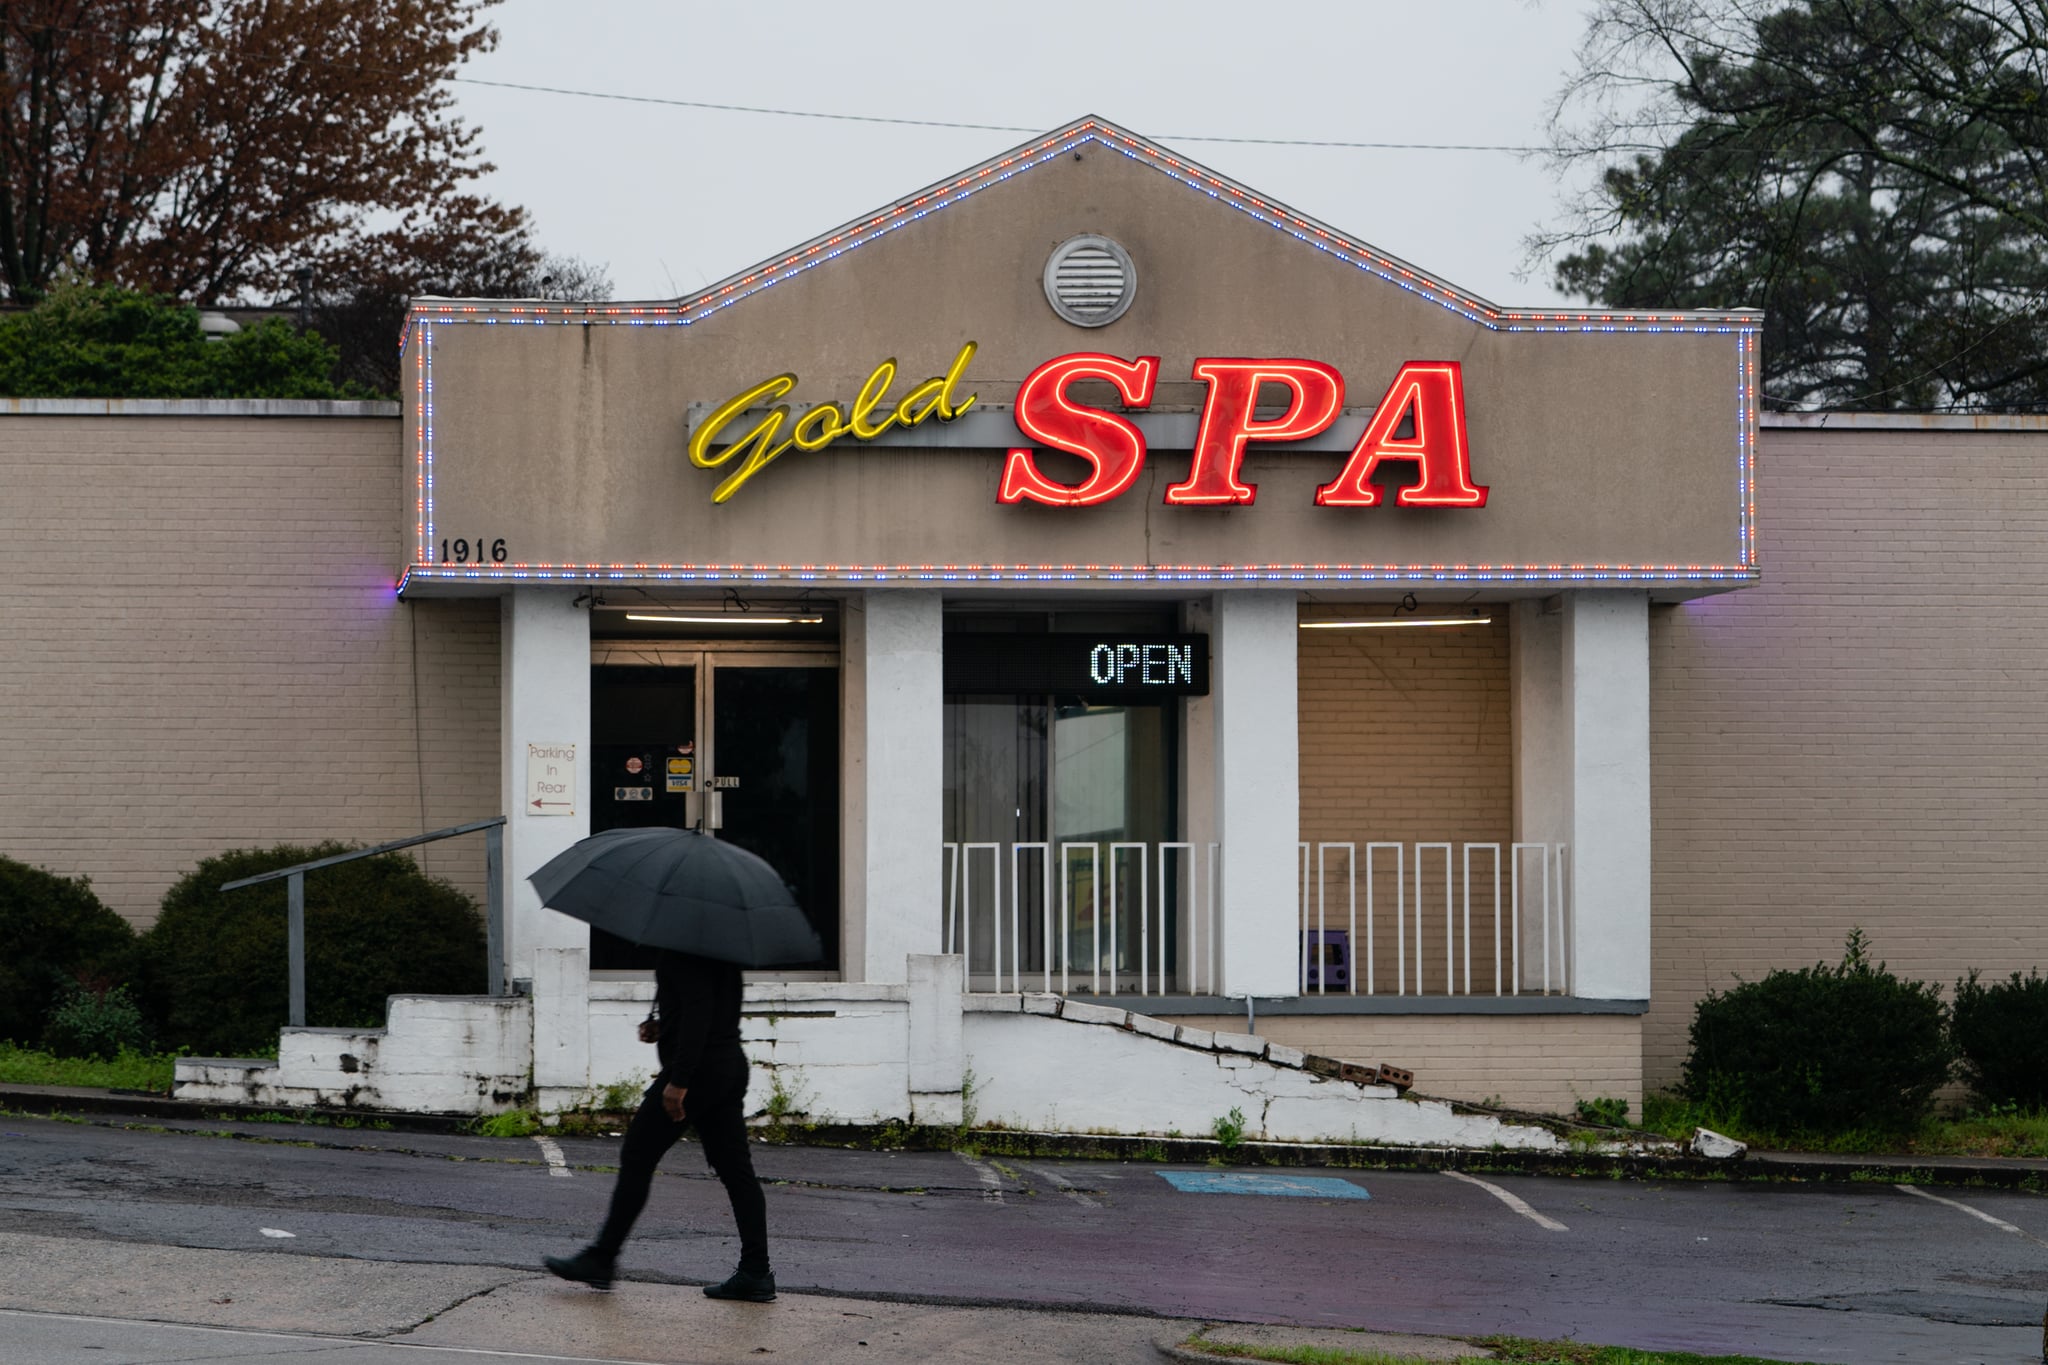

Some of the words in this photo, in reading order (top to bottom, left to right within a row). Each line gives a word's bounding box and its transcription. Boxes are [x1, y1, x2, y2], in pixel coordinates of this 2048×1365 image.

[687, 340, 979, 504] Gold
[996, 352, 1489, 508] SPA
[442, 538, 507, 562] 1916
[1090, 644, 1191, 684] OPEN
[530, 746, 575, 761] Parking
[546, 764, 557, 776] In
[537, 781, 567, 793] Rear
[714, 777, 737, 787] PULL
